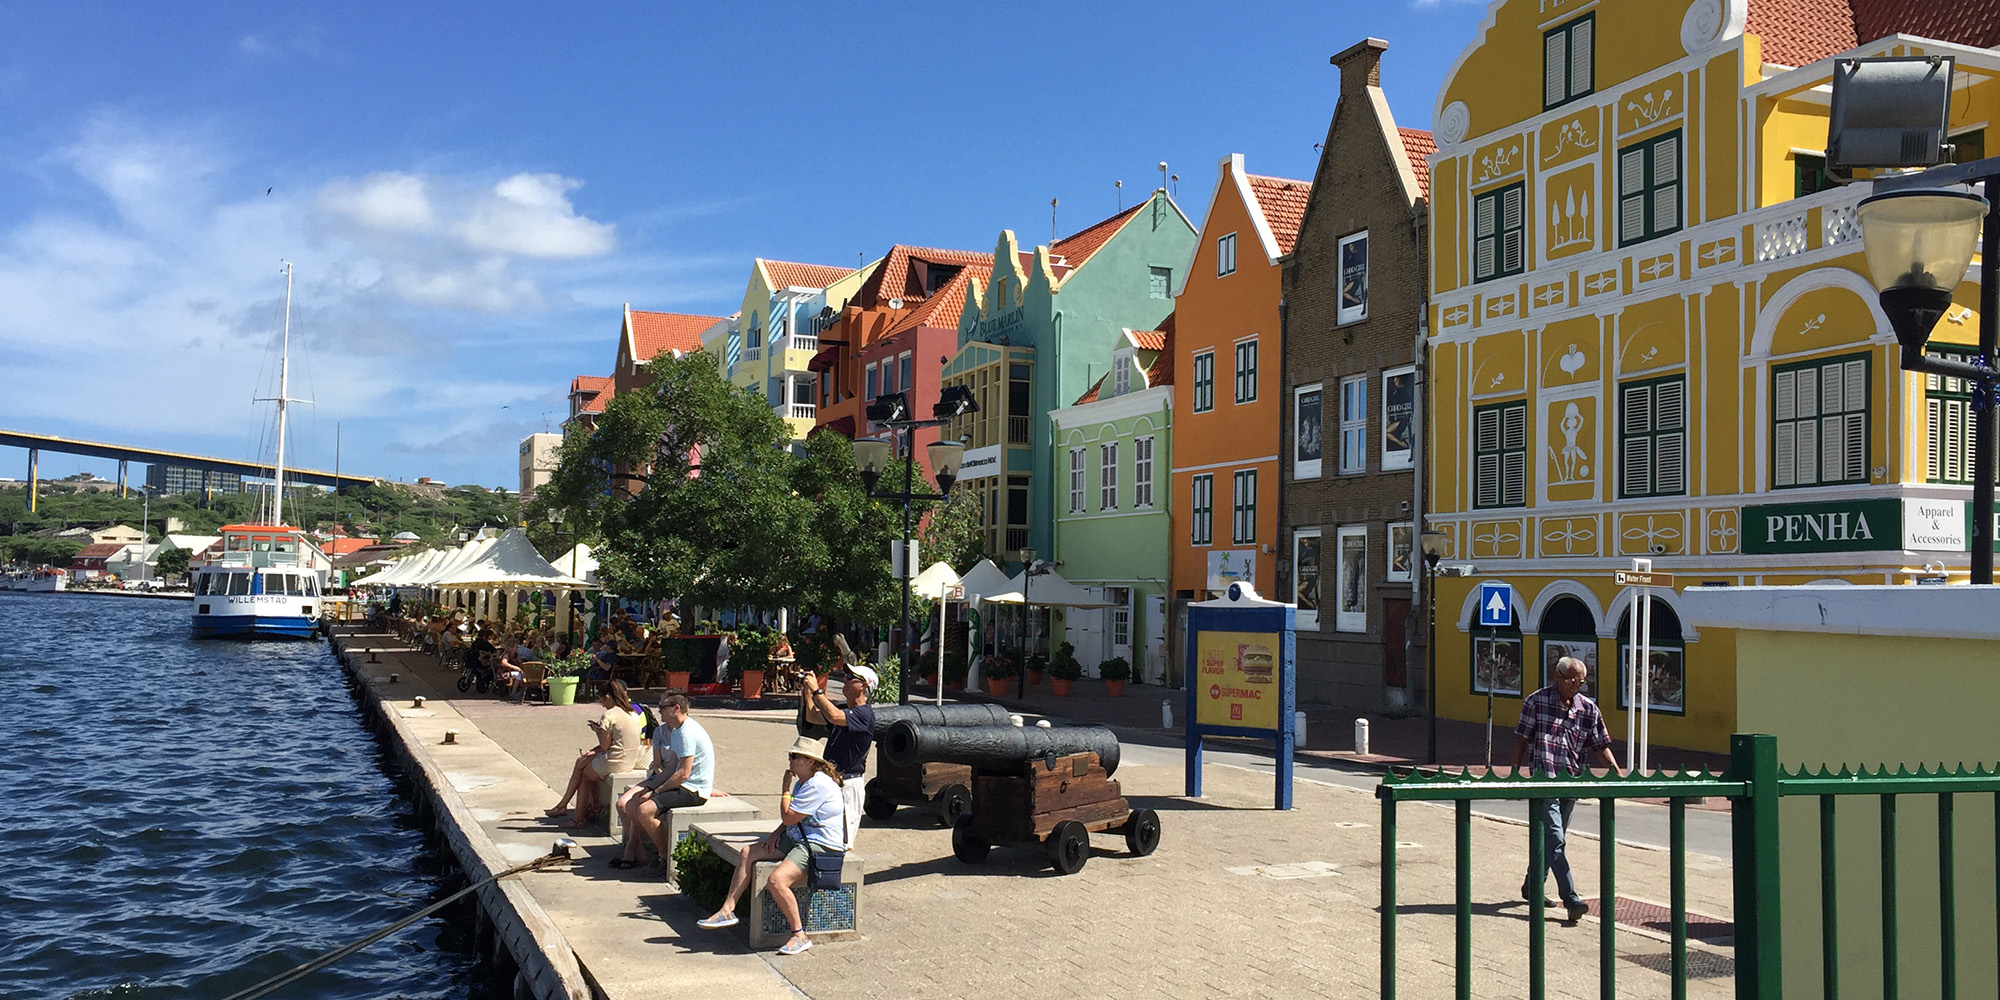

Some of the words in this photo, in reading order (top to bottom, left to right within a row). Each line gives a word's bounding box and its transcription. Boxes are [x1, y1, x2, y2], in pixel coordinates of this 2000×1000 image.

[979, 318, 997, 337] BLUE
[997, 306, 1024, 329] MARLIN
[1917, 505, 1954, 519] Apparel
[1766, 511, 1874, 543] PENHA
[1931, 519, 1941, 531] &
[1909, 532, 1962, 545] Accessories
[1202, 667, 1224, 675] FLAVOR
[1221, 688, 1261, 700] SUPERMAC
